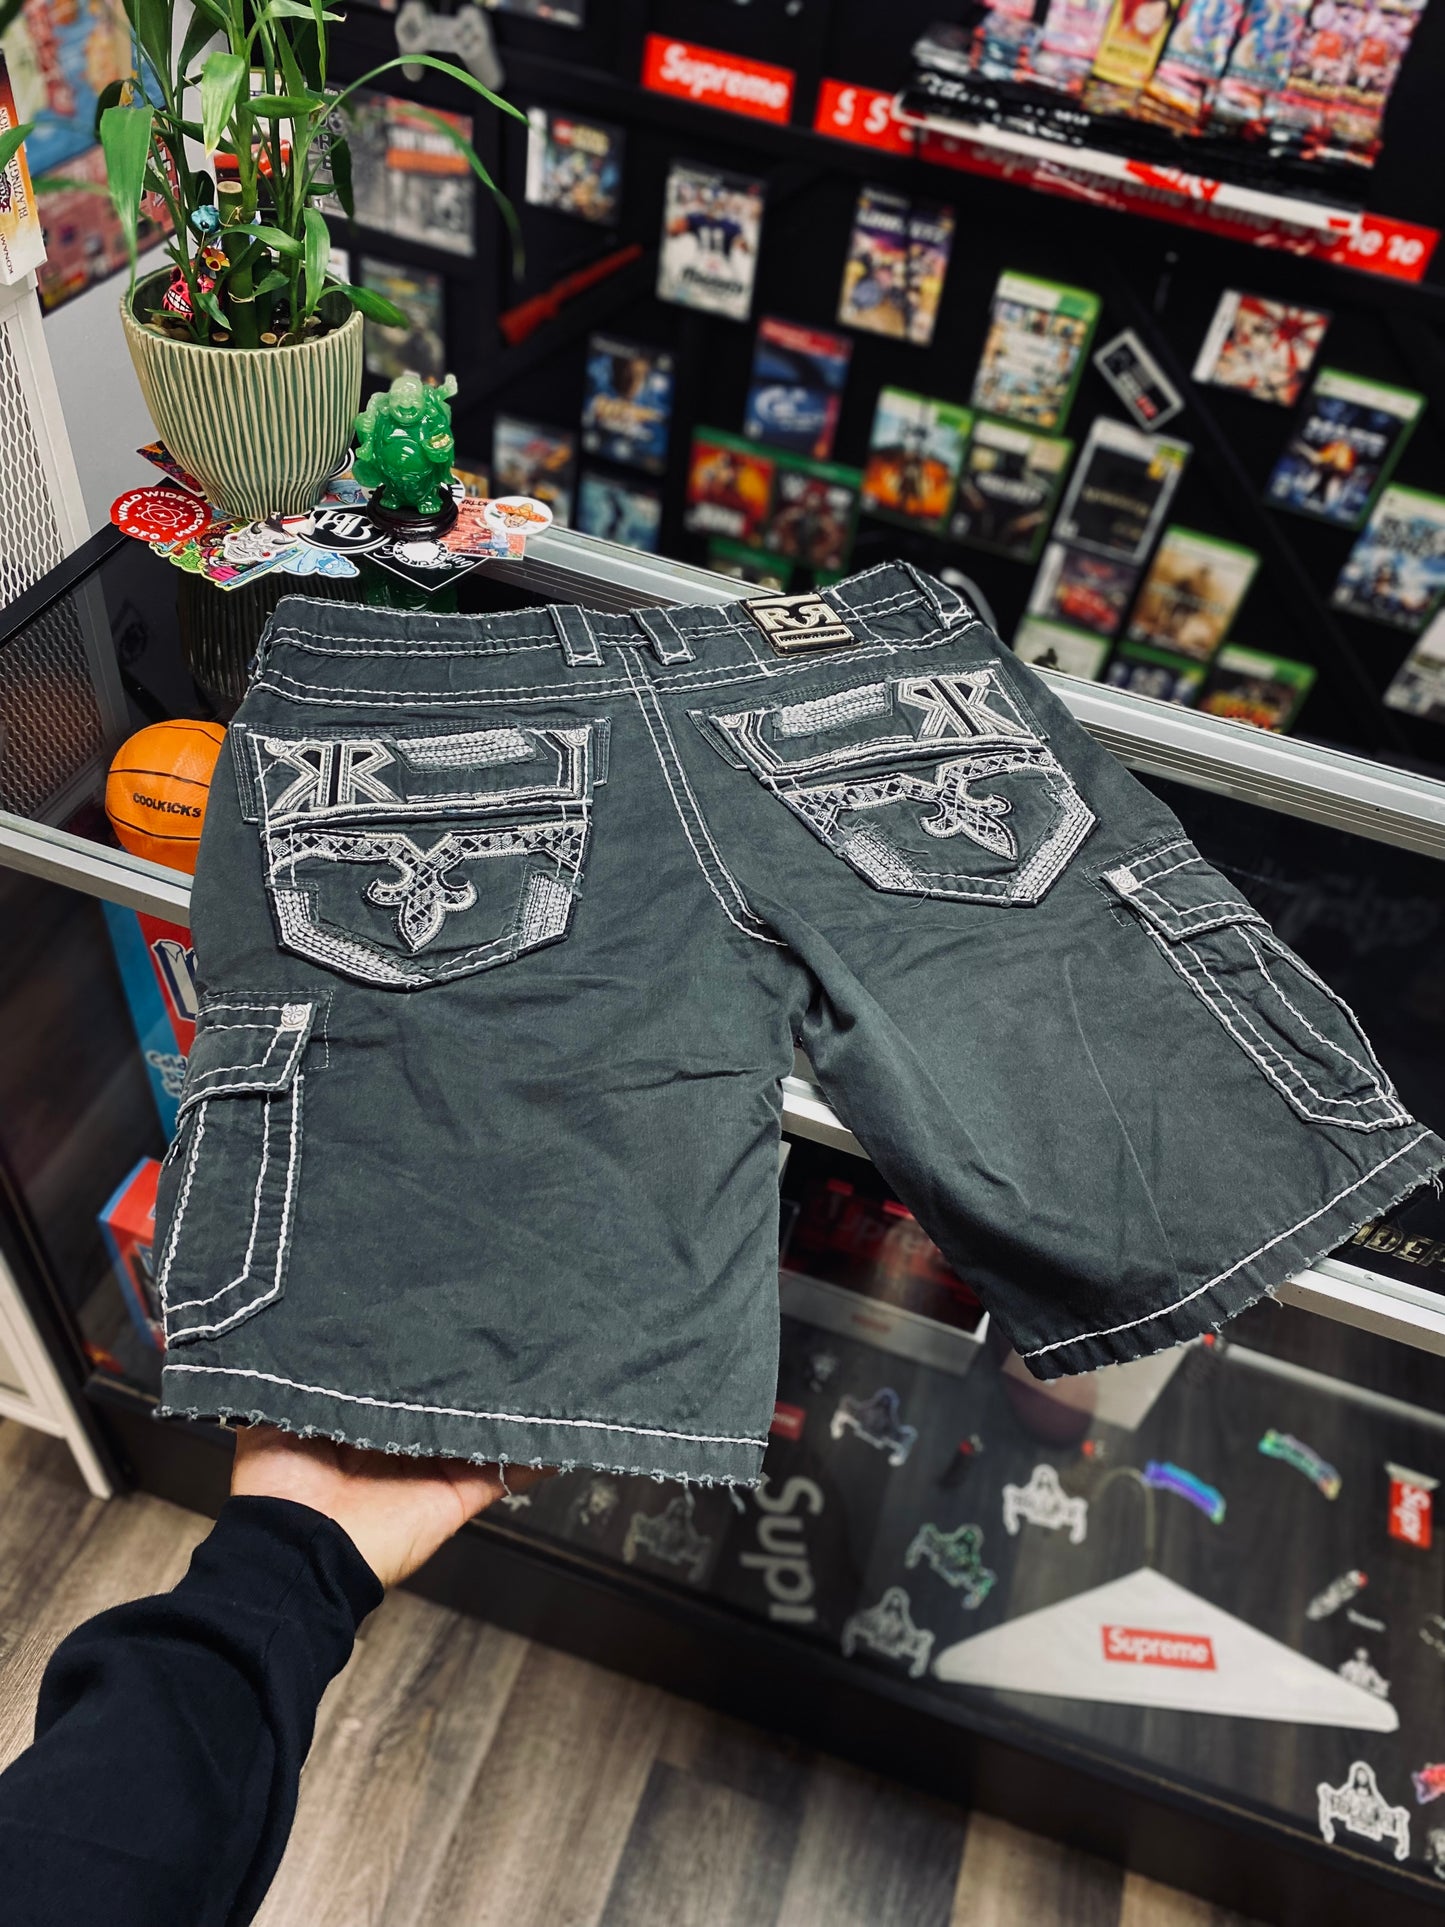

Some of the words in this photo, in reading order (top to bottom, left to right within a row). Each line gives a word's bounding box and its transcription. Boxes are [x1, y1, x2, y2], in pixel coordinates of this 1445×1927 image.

[660, 44, 788, 108] Supreme
[9, 168, 29, 219] BLAZING
[0, 233, 14, 275] KONAMI
[117, 493, 143, 522] WRLD
[143, 490, 187, 502] WIDE
[132, 792, 202, 818] COOLKICKS
[1107, 1628, 1209, 1664] Supreme
